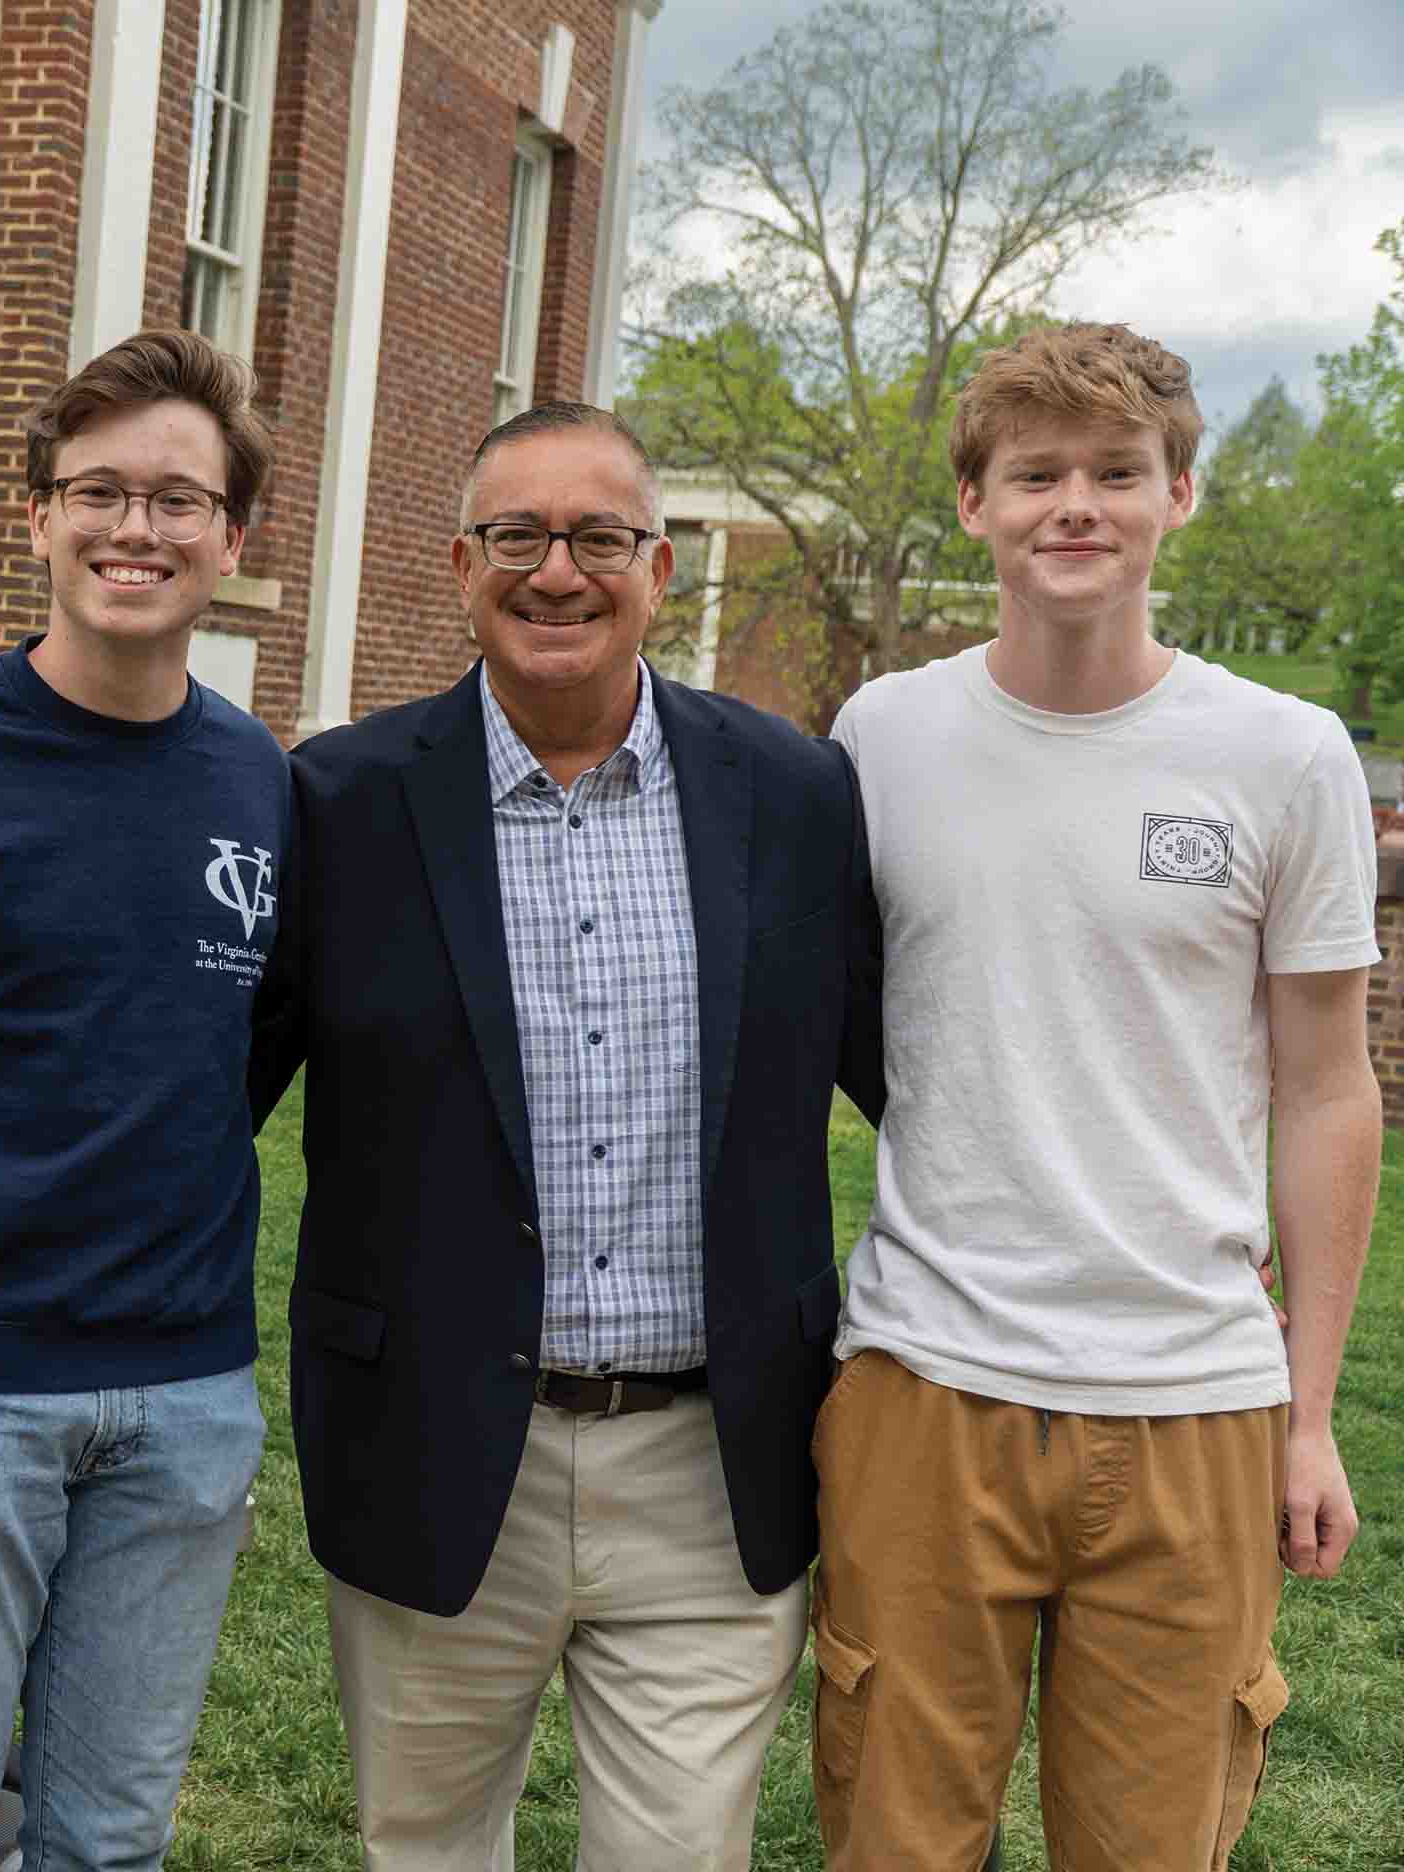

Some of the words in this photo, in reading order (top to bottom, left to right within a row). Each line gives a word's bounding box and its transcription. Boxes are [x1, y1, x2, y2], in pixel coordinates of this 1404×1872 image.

[1175, 836, 1201, 865] 30
[197, 939, 215, 953] The
[216, 942, 249, 960] Virginia
[196, 959, 203, 968] at
[204, 957, 217, 969] the
[218, 959, 252, 977] University
